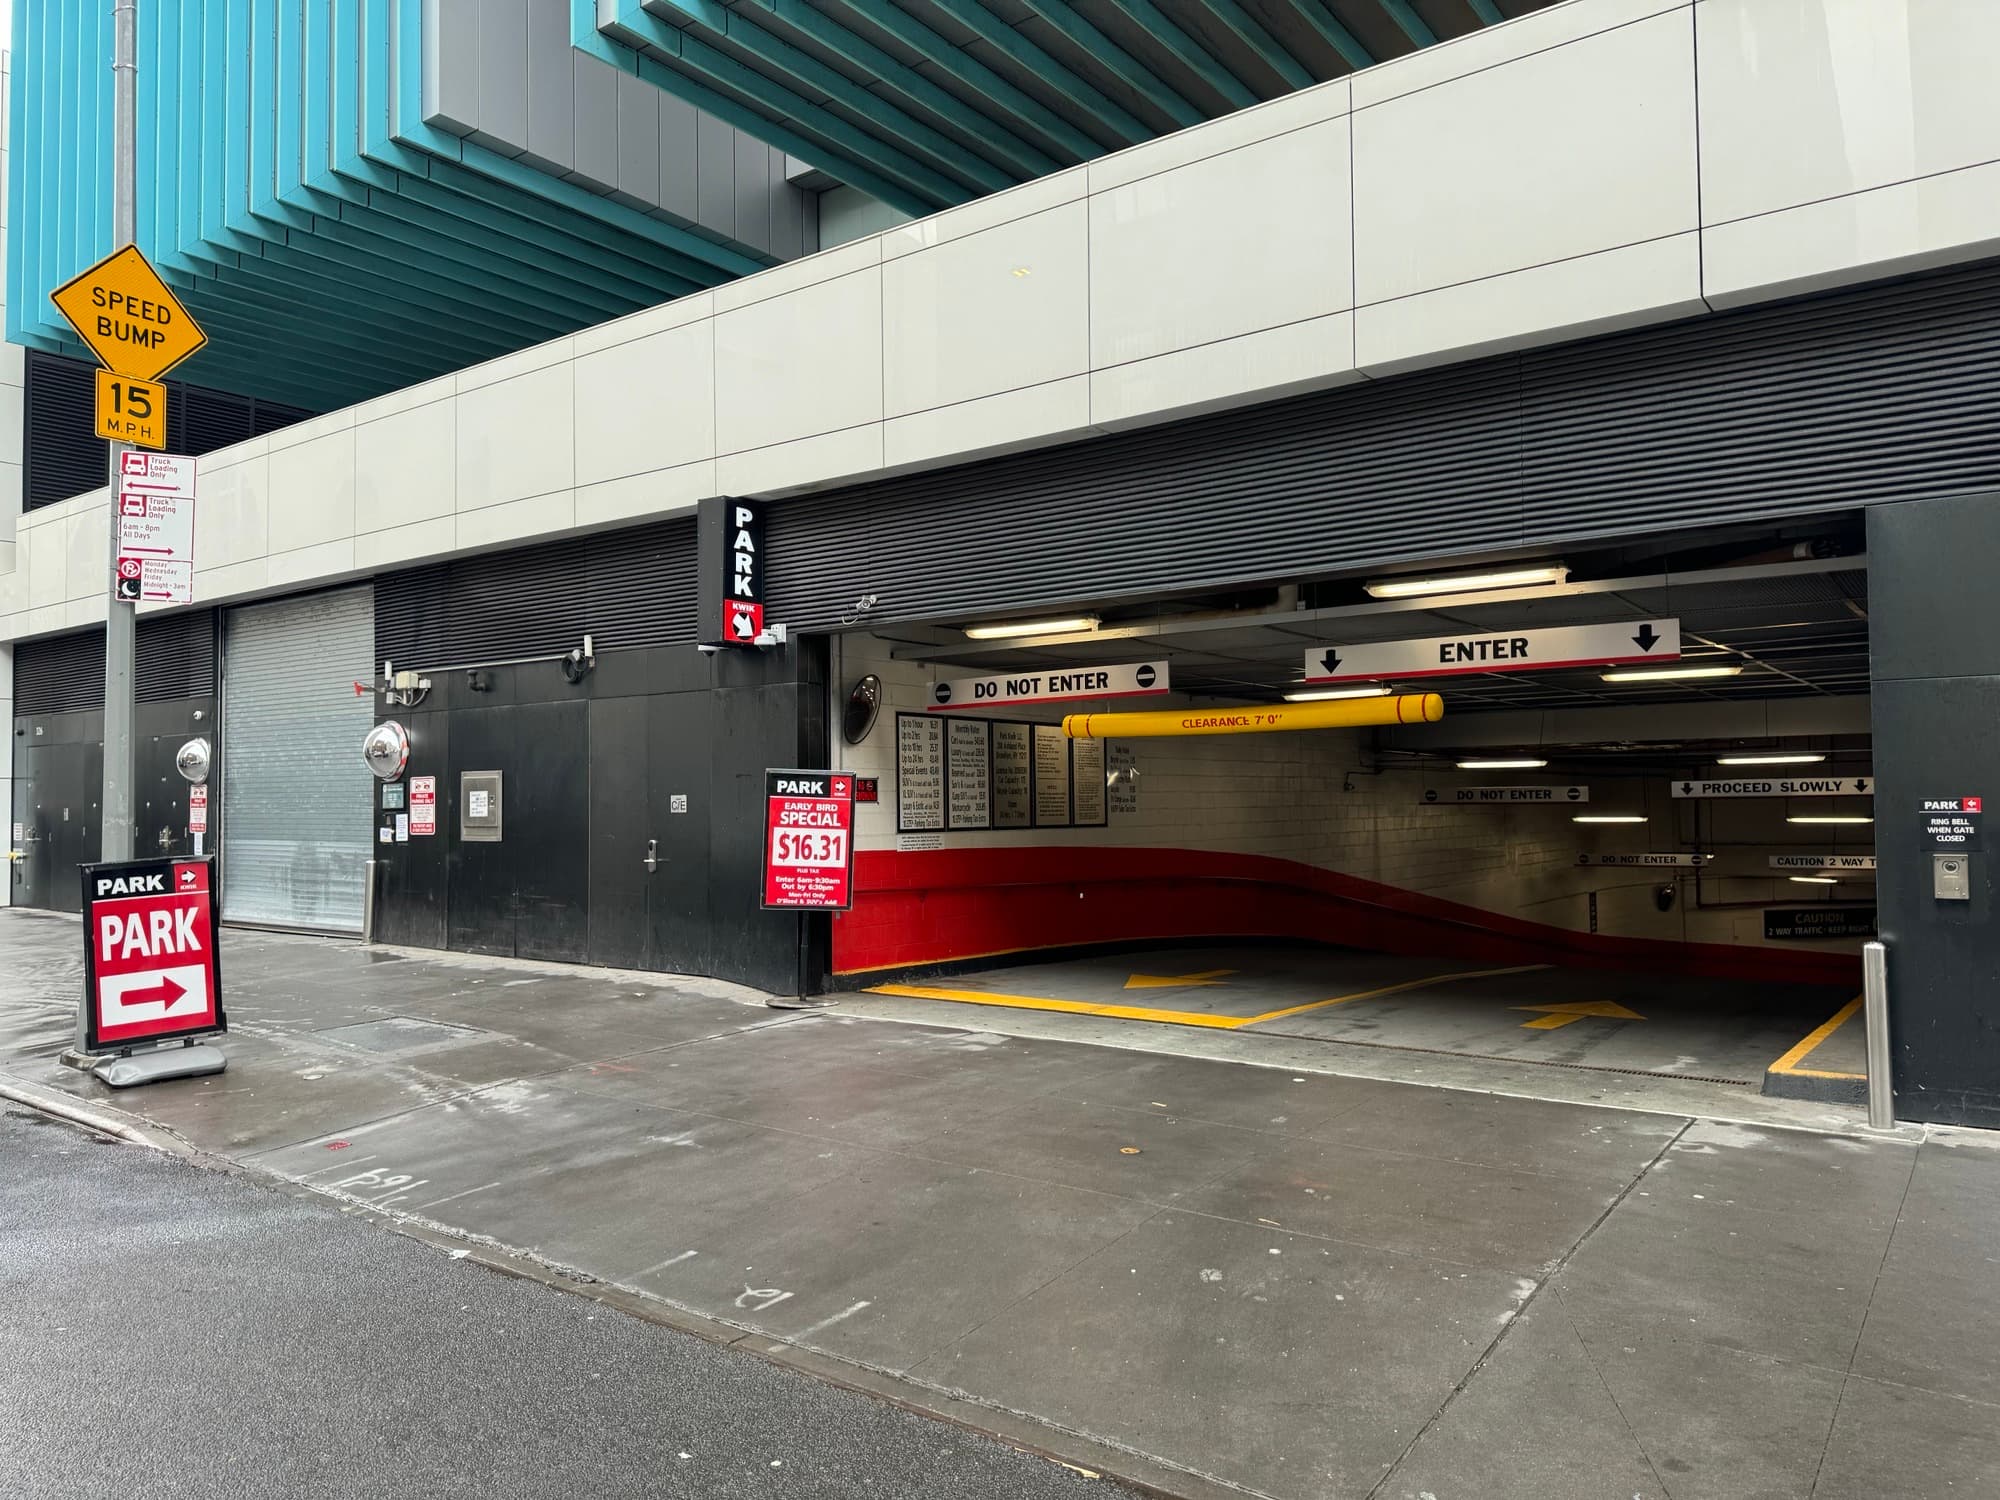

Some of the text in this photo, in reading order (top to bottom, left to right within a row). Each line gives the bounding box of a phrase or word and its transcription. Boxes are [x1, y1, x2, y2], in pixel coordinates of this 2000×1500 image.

[92, 286, 171, 325] SPEED
[97, 315, 166, 349] BUMP
[111, 382, 152, 419] 15
[151, 457, 171, 465] Truck
[150, 464, 178, 473] Loading
[150, 471, 165, 479] Only
[149, 505, 176, 513] Loading
[149, 512, 164, 520] Only
[145, 524, 160, 532] 8pm
[134, 532, 150, 540] Days
[734, 507, 755, 597] PARK
[732, 602, 755, 613] KWIK
[1440, 638, 1528, 663] ENTER
[975, 672, 1109, 698] DO NOT ENTER
[1182, 716, 1250, 729] CLEARANCE
[777, 780, 824, 794] PARK
[1703, 781, 1842, 794] PROCEED SLOWLY
[1457, 790, 1552, 800] DO NOT ENTER
[785, 802, 839, 812] EARLY BIRD
[1924, 801, 1959, 810] PARK
[780, 812, 841, 827] SPECIAL
[779, 831, 841, 863] $16.31
[1602, 856, 1677, 864] DO NOT ENTER
[1777, 858, 1824, 866] CAUTION
[1829, 858, 1836, 866] 2
[1841, 858, 1864, 866] WAY
[98, 874, 164, 896] PARK
[808, 884, 834, 892] 6:30pm
[1796, 912, 1845, 924] CAUTION
[101, 907, 202, 962] PARK
[1768, 928, 1774, 936] 2
[1776, 928, 1791, 936] WAY
[1795, 926, 1823, 935] TRAFFIC
